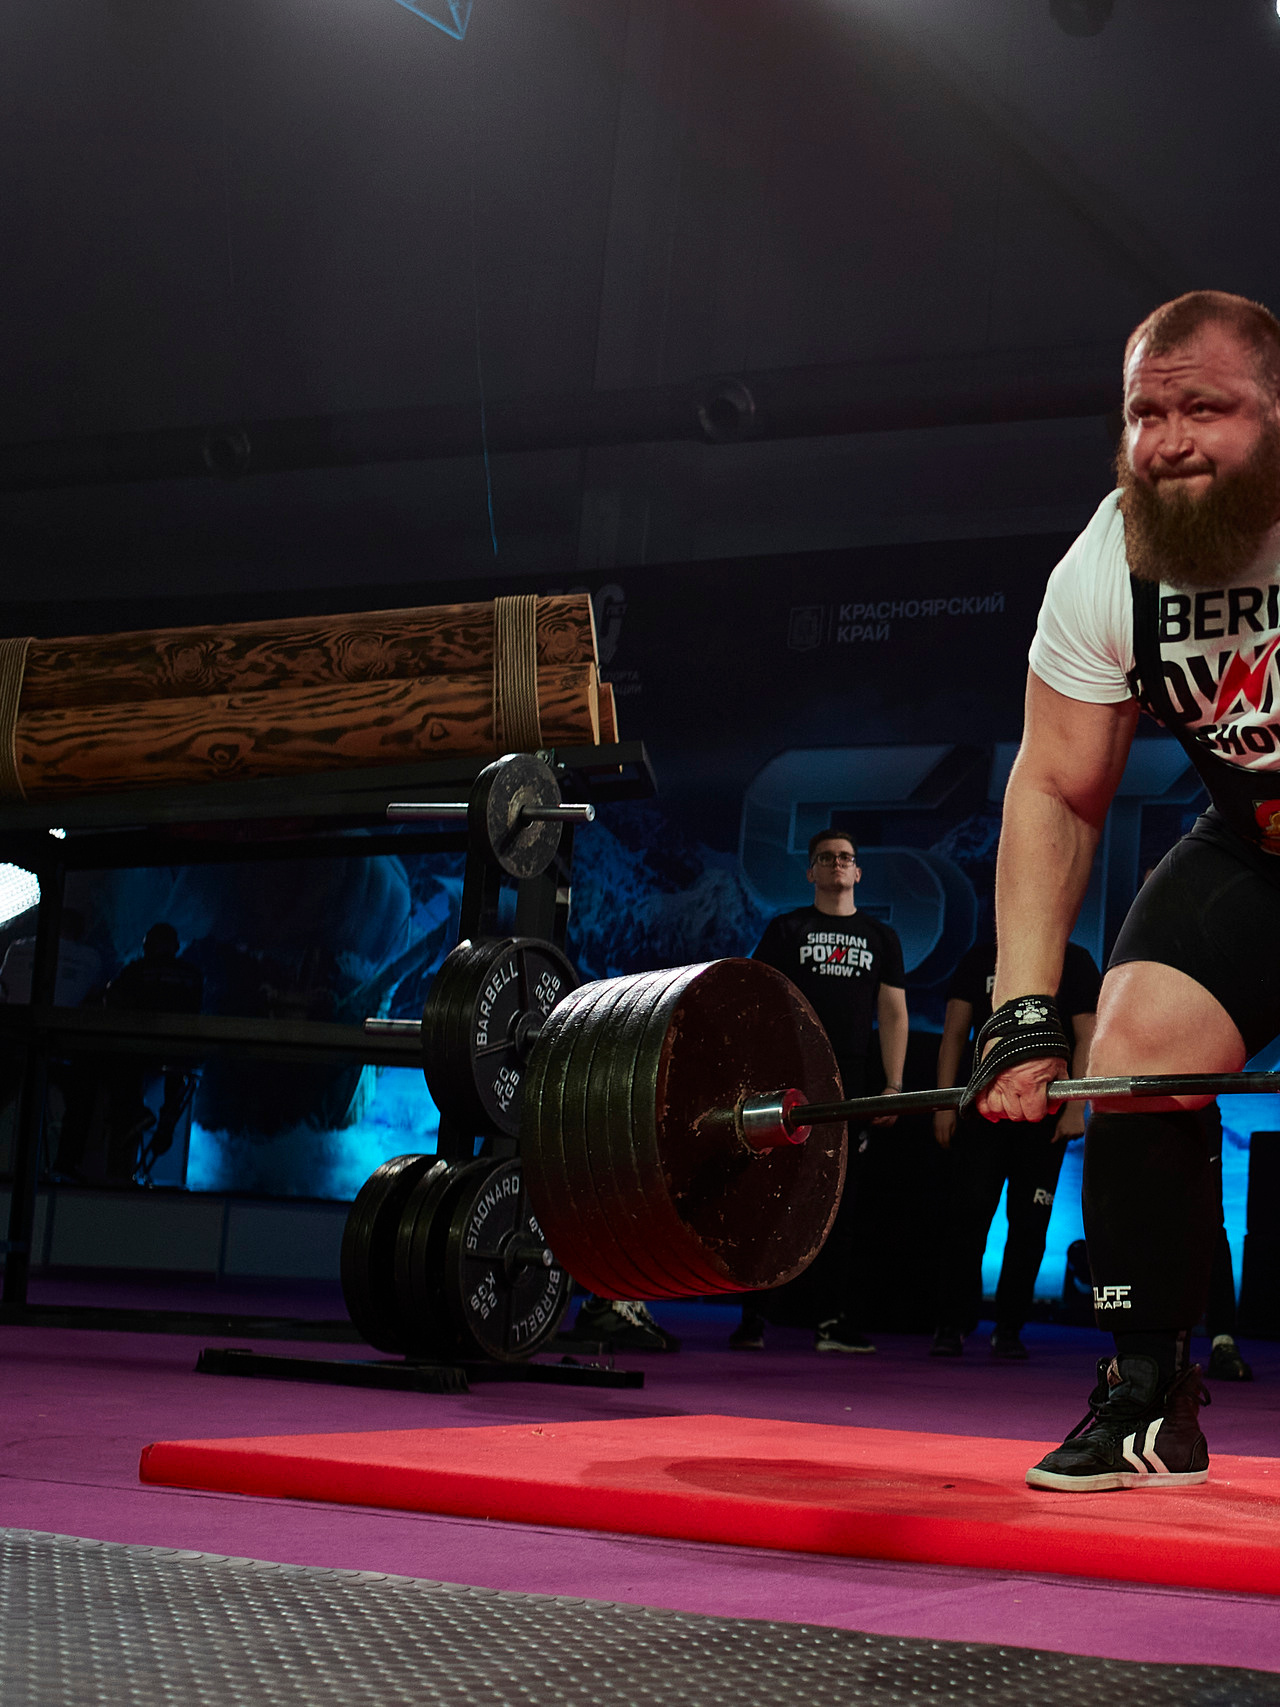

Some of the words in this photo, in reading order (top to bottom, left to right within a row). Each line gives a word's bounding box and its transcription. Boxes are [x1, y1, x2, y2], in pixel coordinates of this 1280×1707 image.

[839, 592, 1005, 621] КРАСНОЯРСКИЙ
[837, 620, 890, 643] КРАЙ
[807, 931, 867, 950] SIBERIAN
[799, 944, 874, 972] POWER
[819, 963, 854, 978] SHOW
[534, 971, 552, 998] 20
[476, 960, 519, 1047] BARBELL
[493, 1066, 510, 1092] 20
[496, 1070, 521, 1113] KGS
[512, 1268, 561, 1342] BARBELL
